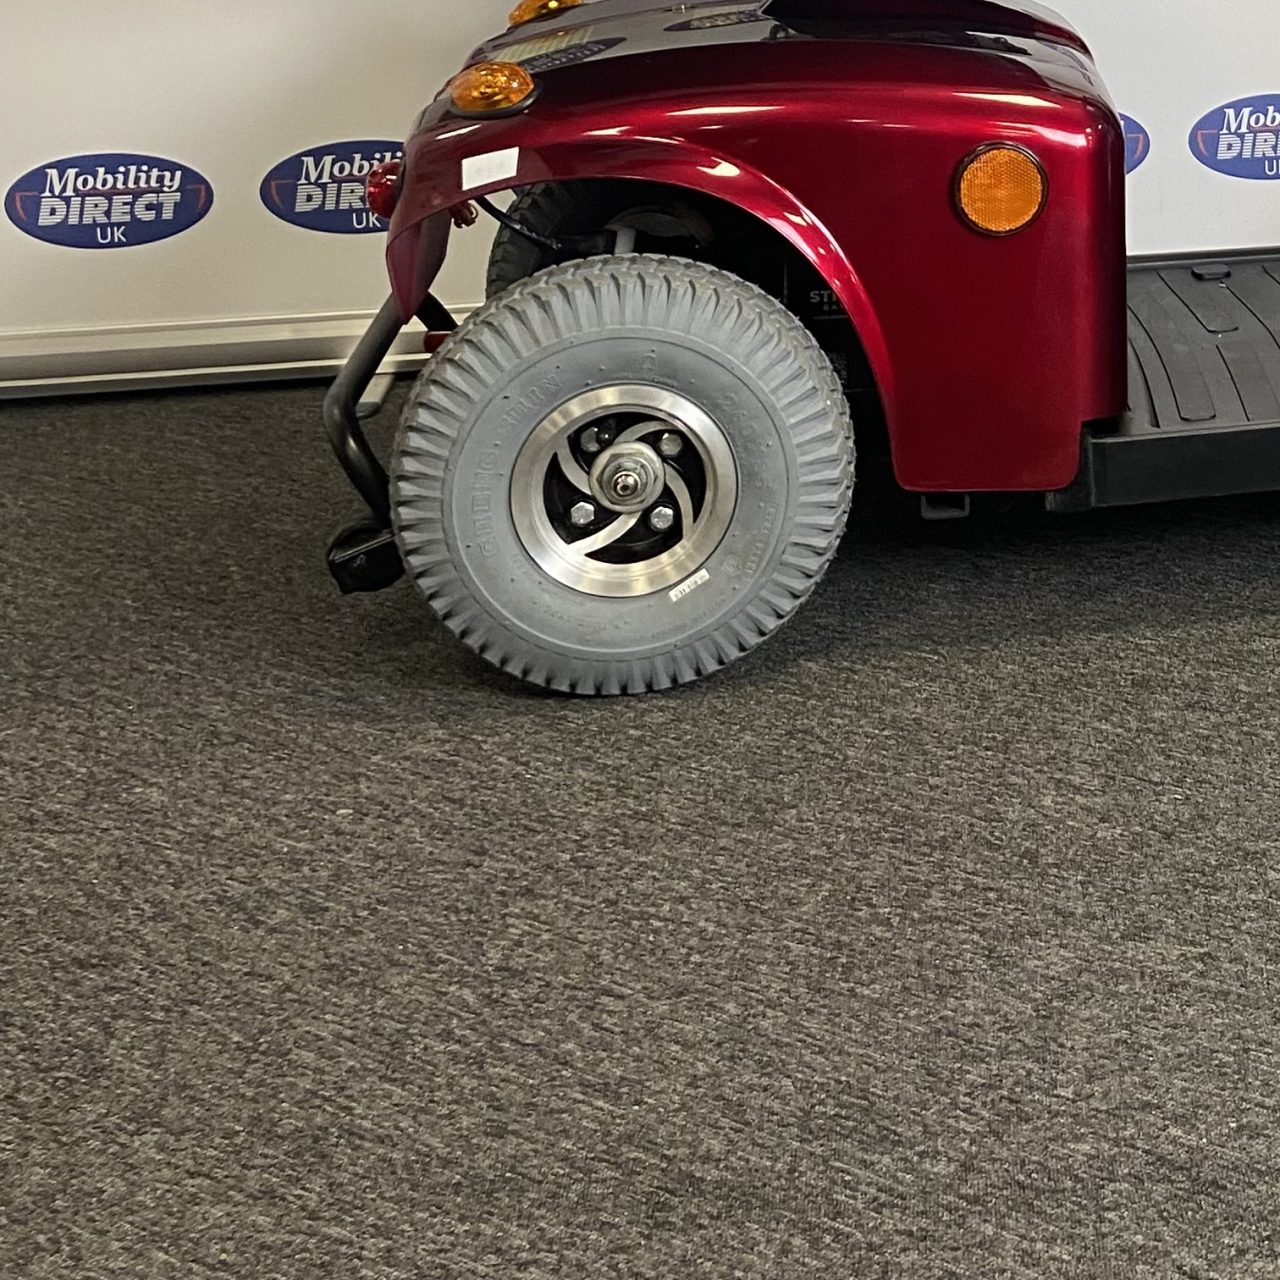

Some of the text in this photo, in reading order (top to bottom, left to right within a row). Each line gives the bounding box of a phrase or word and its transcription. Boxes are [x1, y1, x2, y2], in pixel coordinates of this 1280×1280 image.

[41, 166, 181, 196] Mobility
[38, 193, 180, 225] DIRECT
[295, 182, 364, 211] DIR
[97, 226, 126, 243] UK
[353, 212, 381, 228] UK
